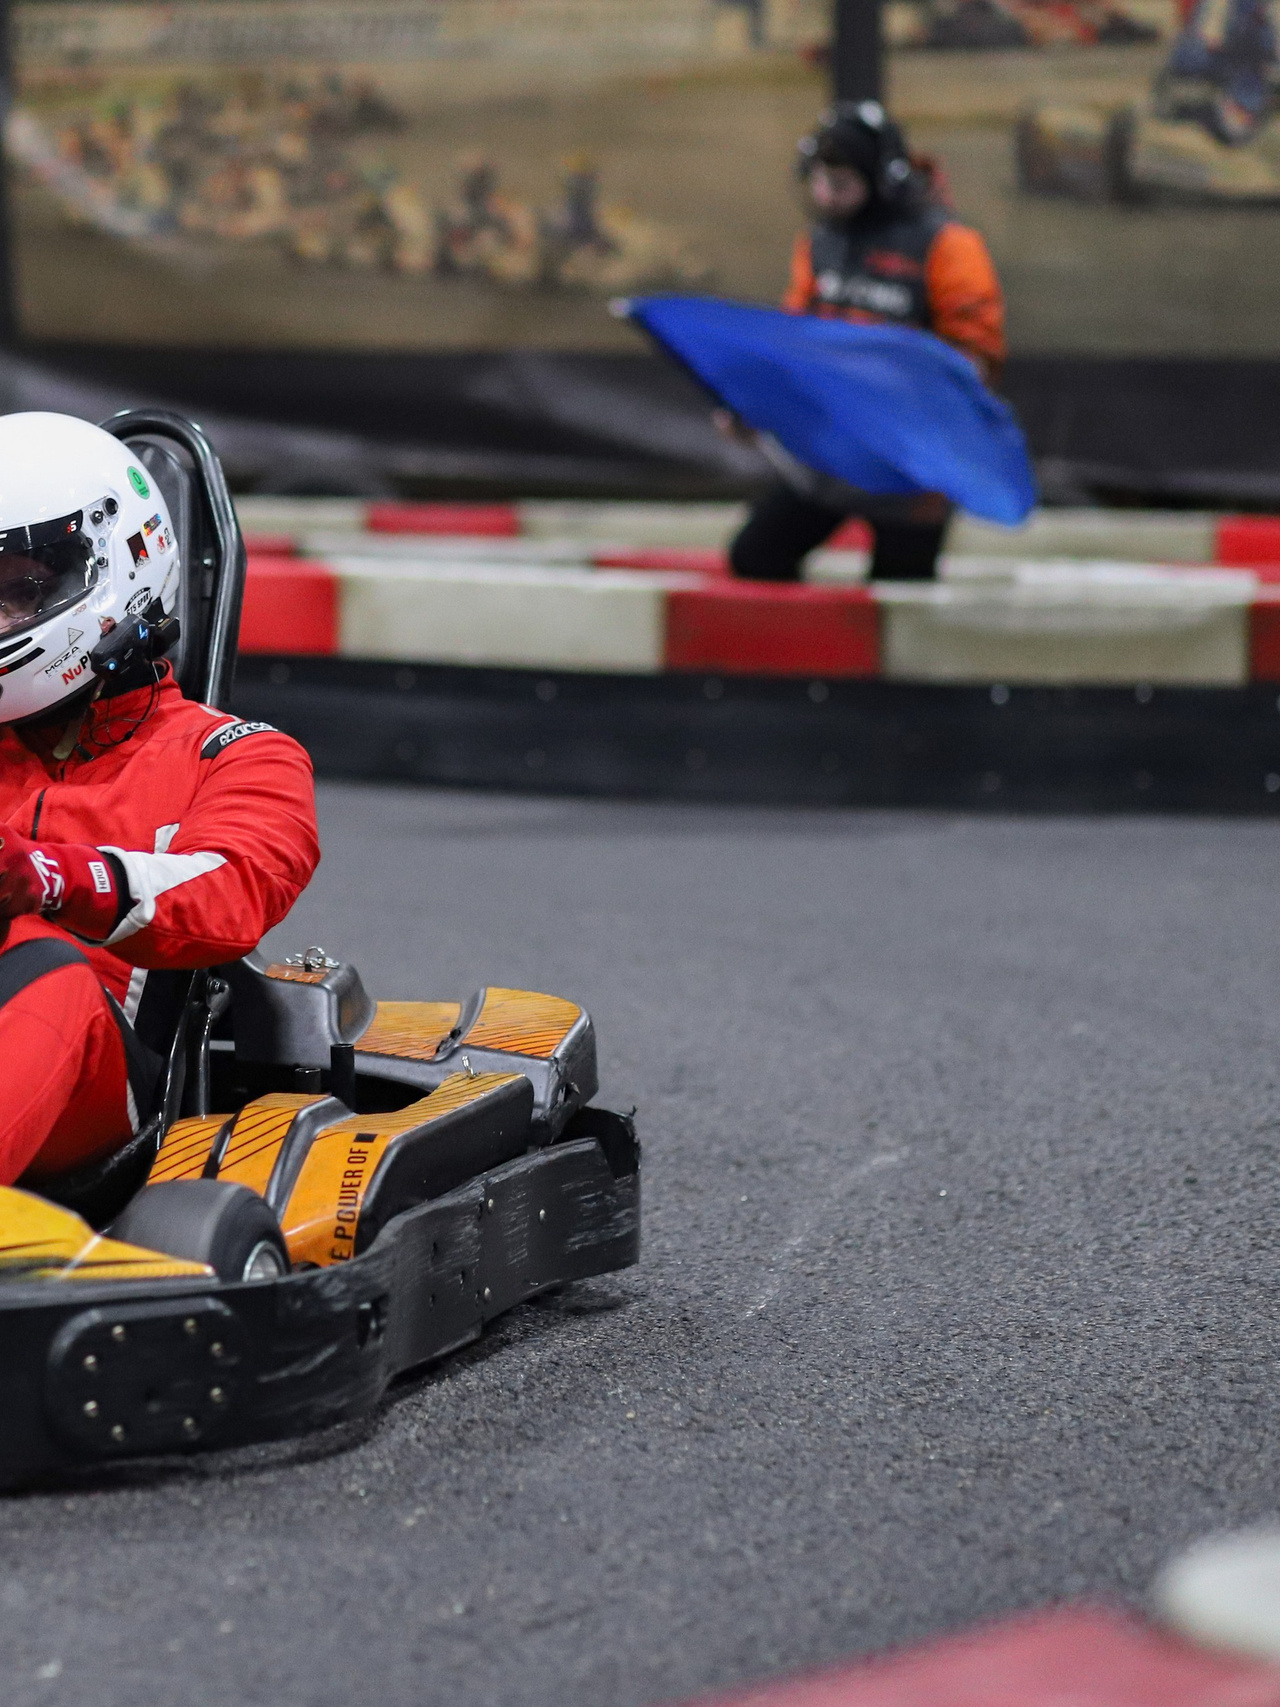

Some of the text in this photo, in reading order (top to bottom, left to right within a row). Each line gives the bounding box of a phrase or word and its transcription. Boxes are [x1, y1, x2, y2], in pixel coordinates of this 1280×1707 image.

[45, 646, 79, 675] MOZA
[347, 1147, 369, 1165] OF
[333, 1169, 364, 1241] POWER
